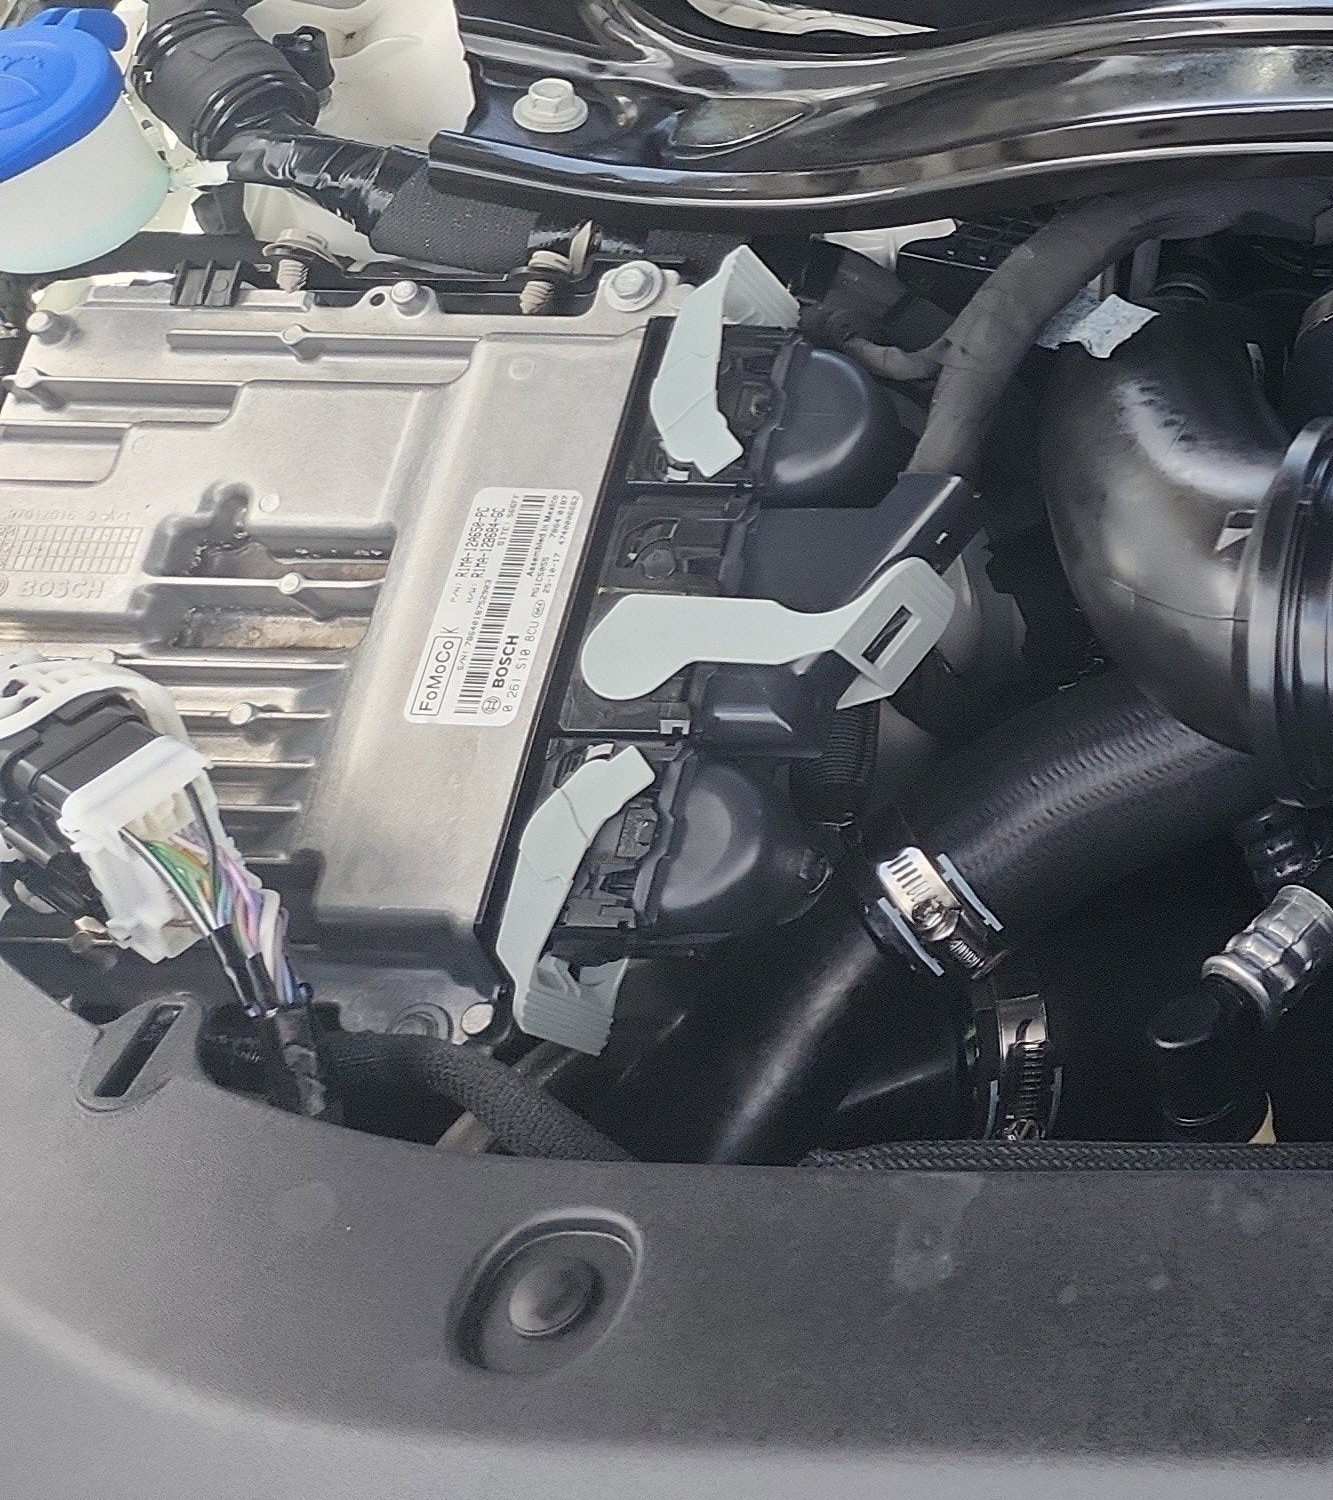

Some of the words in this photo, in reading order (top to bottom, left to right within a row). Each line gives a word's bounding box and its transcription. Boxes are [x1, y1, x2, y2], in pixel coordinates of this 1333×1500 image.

[526, 533, 546, 576] Assembled
[544, 495, 558, 521] Mexico
[19, 579, 105, 599] BOSCH
[542, 552, 561, 593] 25-10-17
[418, 640, 455, 710] FoMoCo
[492, 634, 519, 687] BOSCH
[506, 678, 522, 697] 261
[515, 648, 531, 669] S10
